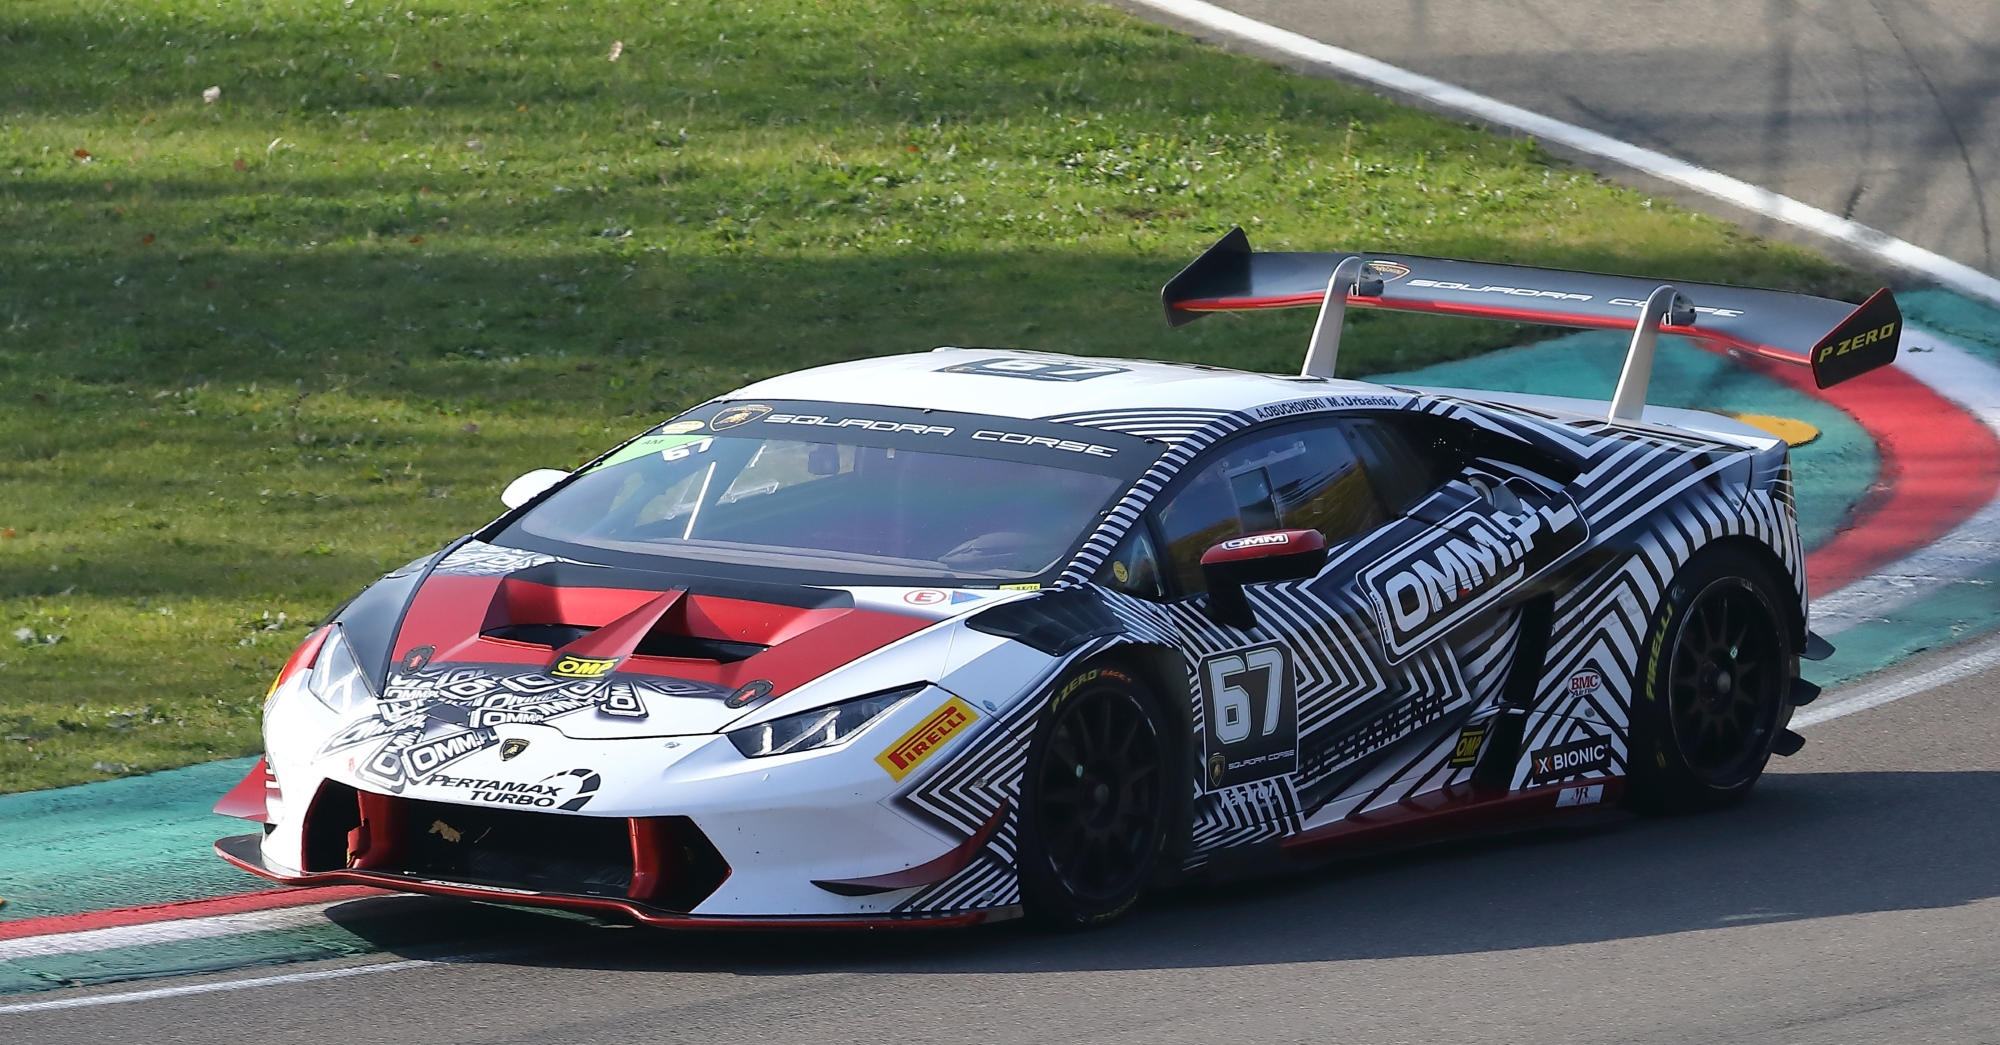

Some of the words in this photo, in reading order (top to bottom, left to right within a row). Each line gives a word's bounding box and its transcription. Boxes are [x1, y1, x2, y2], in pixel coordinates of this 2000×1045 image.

[1406, 279, 1594, 302] SQUADRA
[1608, 297, 1744, 318] CSE
[1818, 346, 1834, 363] P
[1836, 322, 1896, 355] ZERO
[1255, 397, 1326, 419] A.OBUCHOWSKI
[1326, 397, 1344, 408] M.
[763, 413, 956, 437] SQUADRA
[971, 430, 1119, 458] CORSE
[661, 438, 714, 462] 67
[1228, 535, 1285, 548] OMM
[1645, 603, 1674, 701] PIRELLI
[557, 660, 615, 675] OMP
[1061, 668, 1099, 701] ZERO
[1571, 674, 1599, 690] BMC
[1207, 647, 1284, 744] 67
[886, 706, 967, 771] PIRELLI
[1456, 735, 1483, 757] OMP
[1228, 756, 1267, 770] SQUADRA
[1553, 745, 1605, 771] BIONIC
[426, 774, 566, 797] PERTAMAX
[471, 790, 556, 808] TURBO
